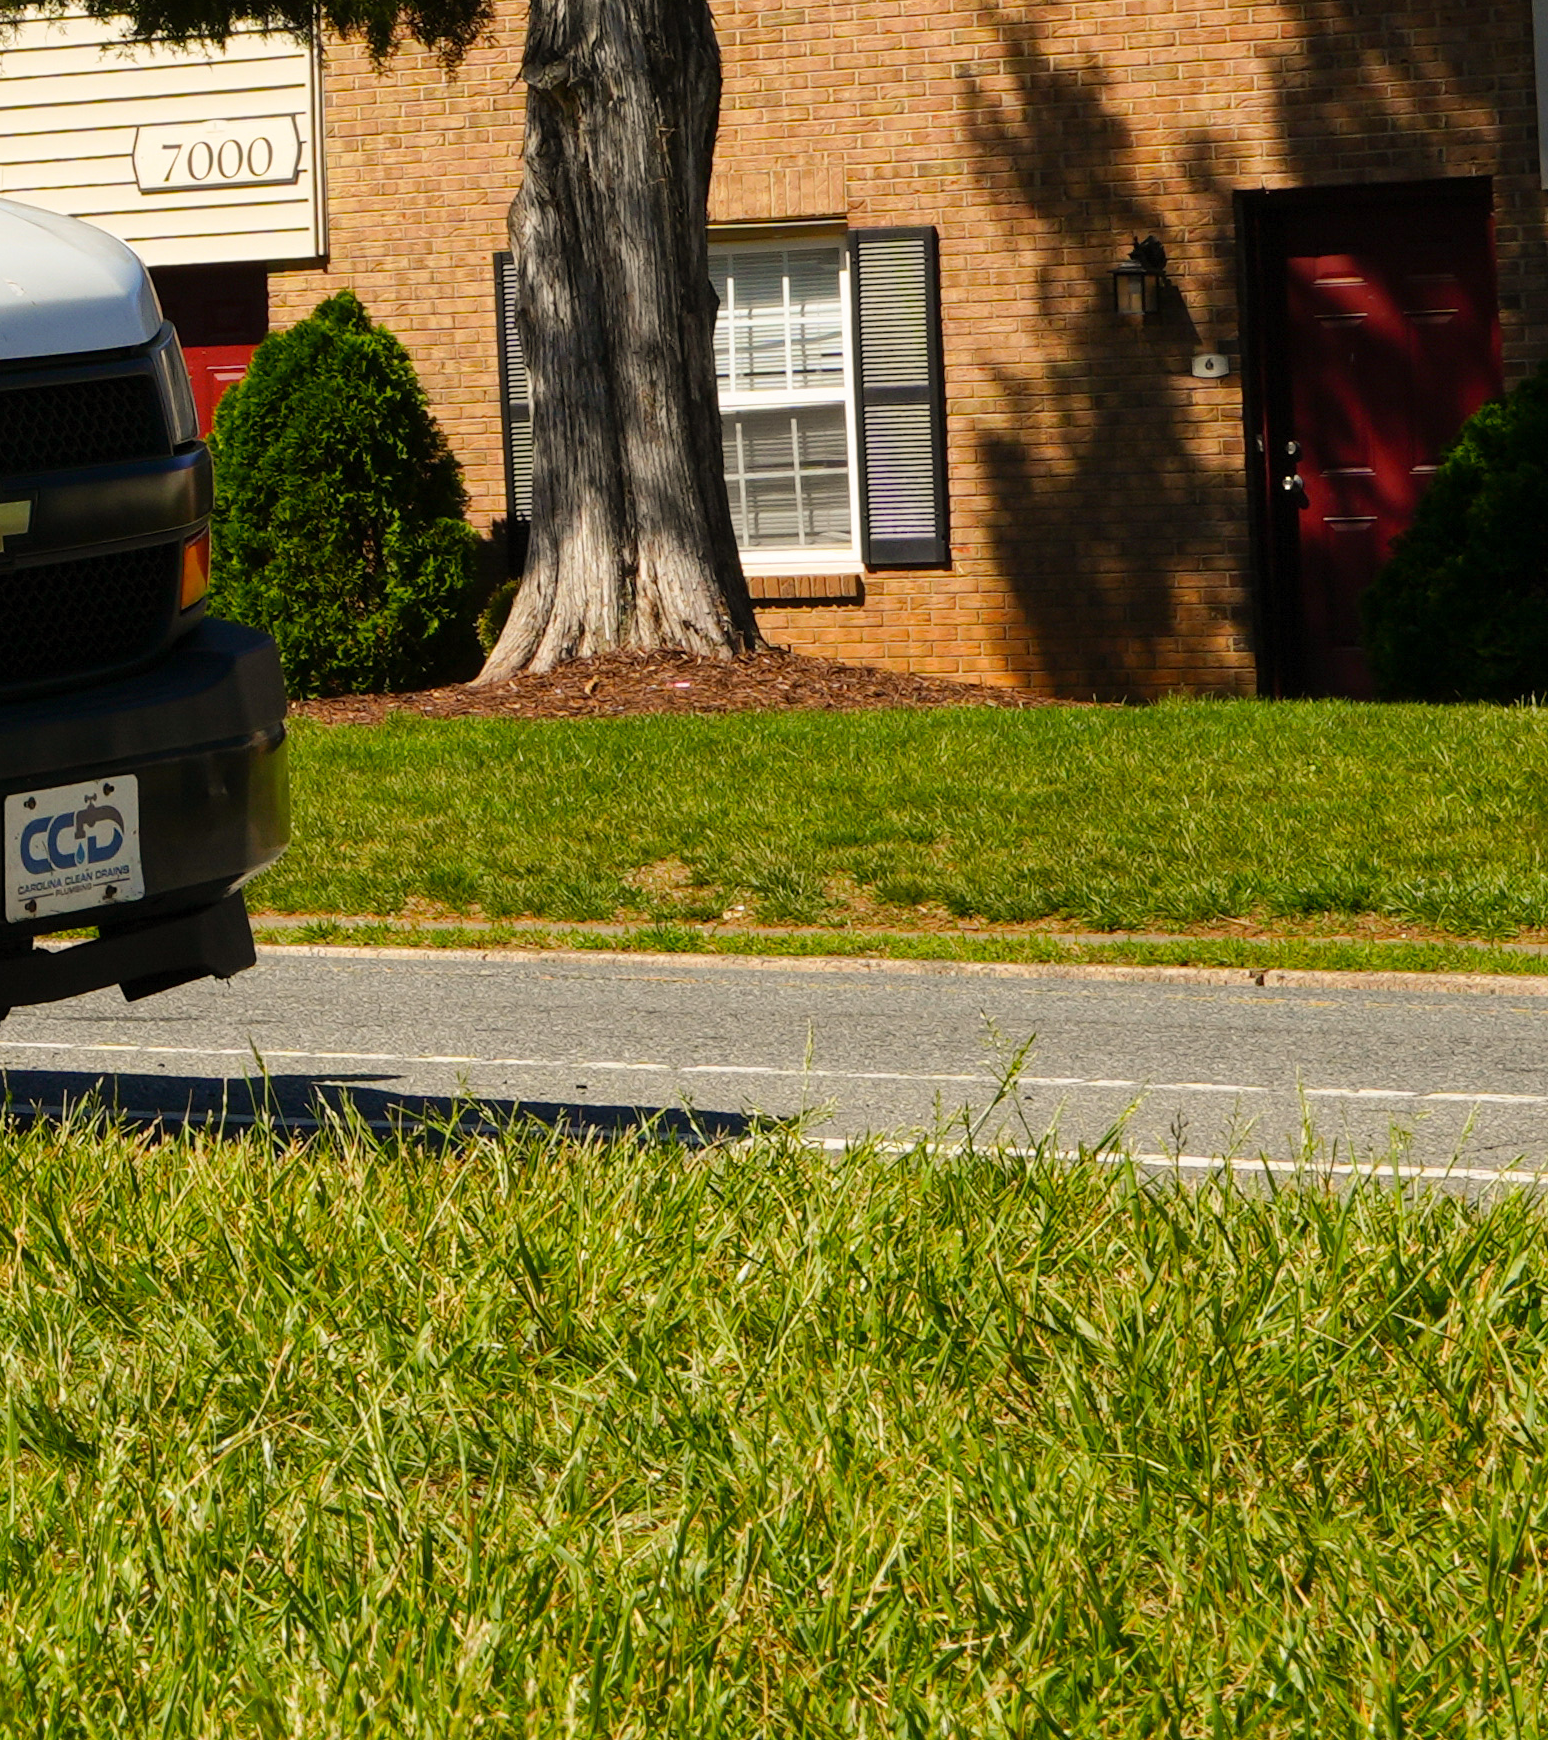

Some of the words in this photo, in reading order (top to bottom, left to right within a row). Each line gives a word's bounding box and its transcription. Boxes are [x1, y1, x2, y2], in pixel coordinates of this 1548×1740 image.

[161, 136, 273, 182] 7000
[17, 878, 62, 895] CAROLINA
[64, 871, 93, 886] CLEAN
[95, 864, 130, 879] DRAINS
[55, 883, 93, 897] PLUMBING
